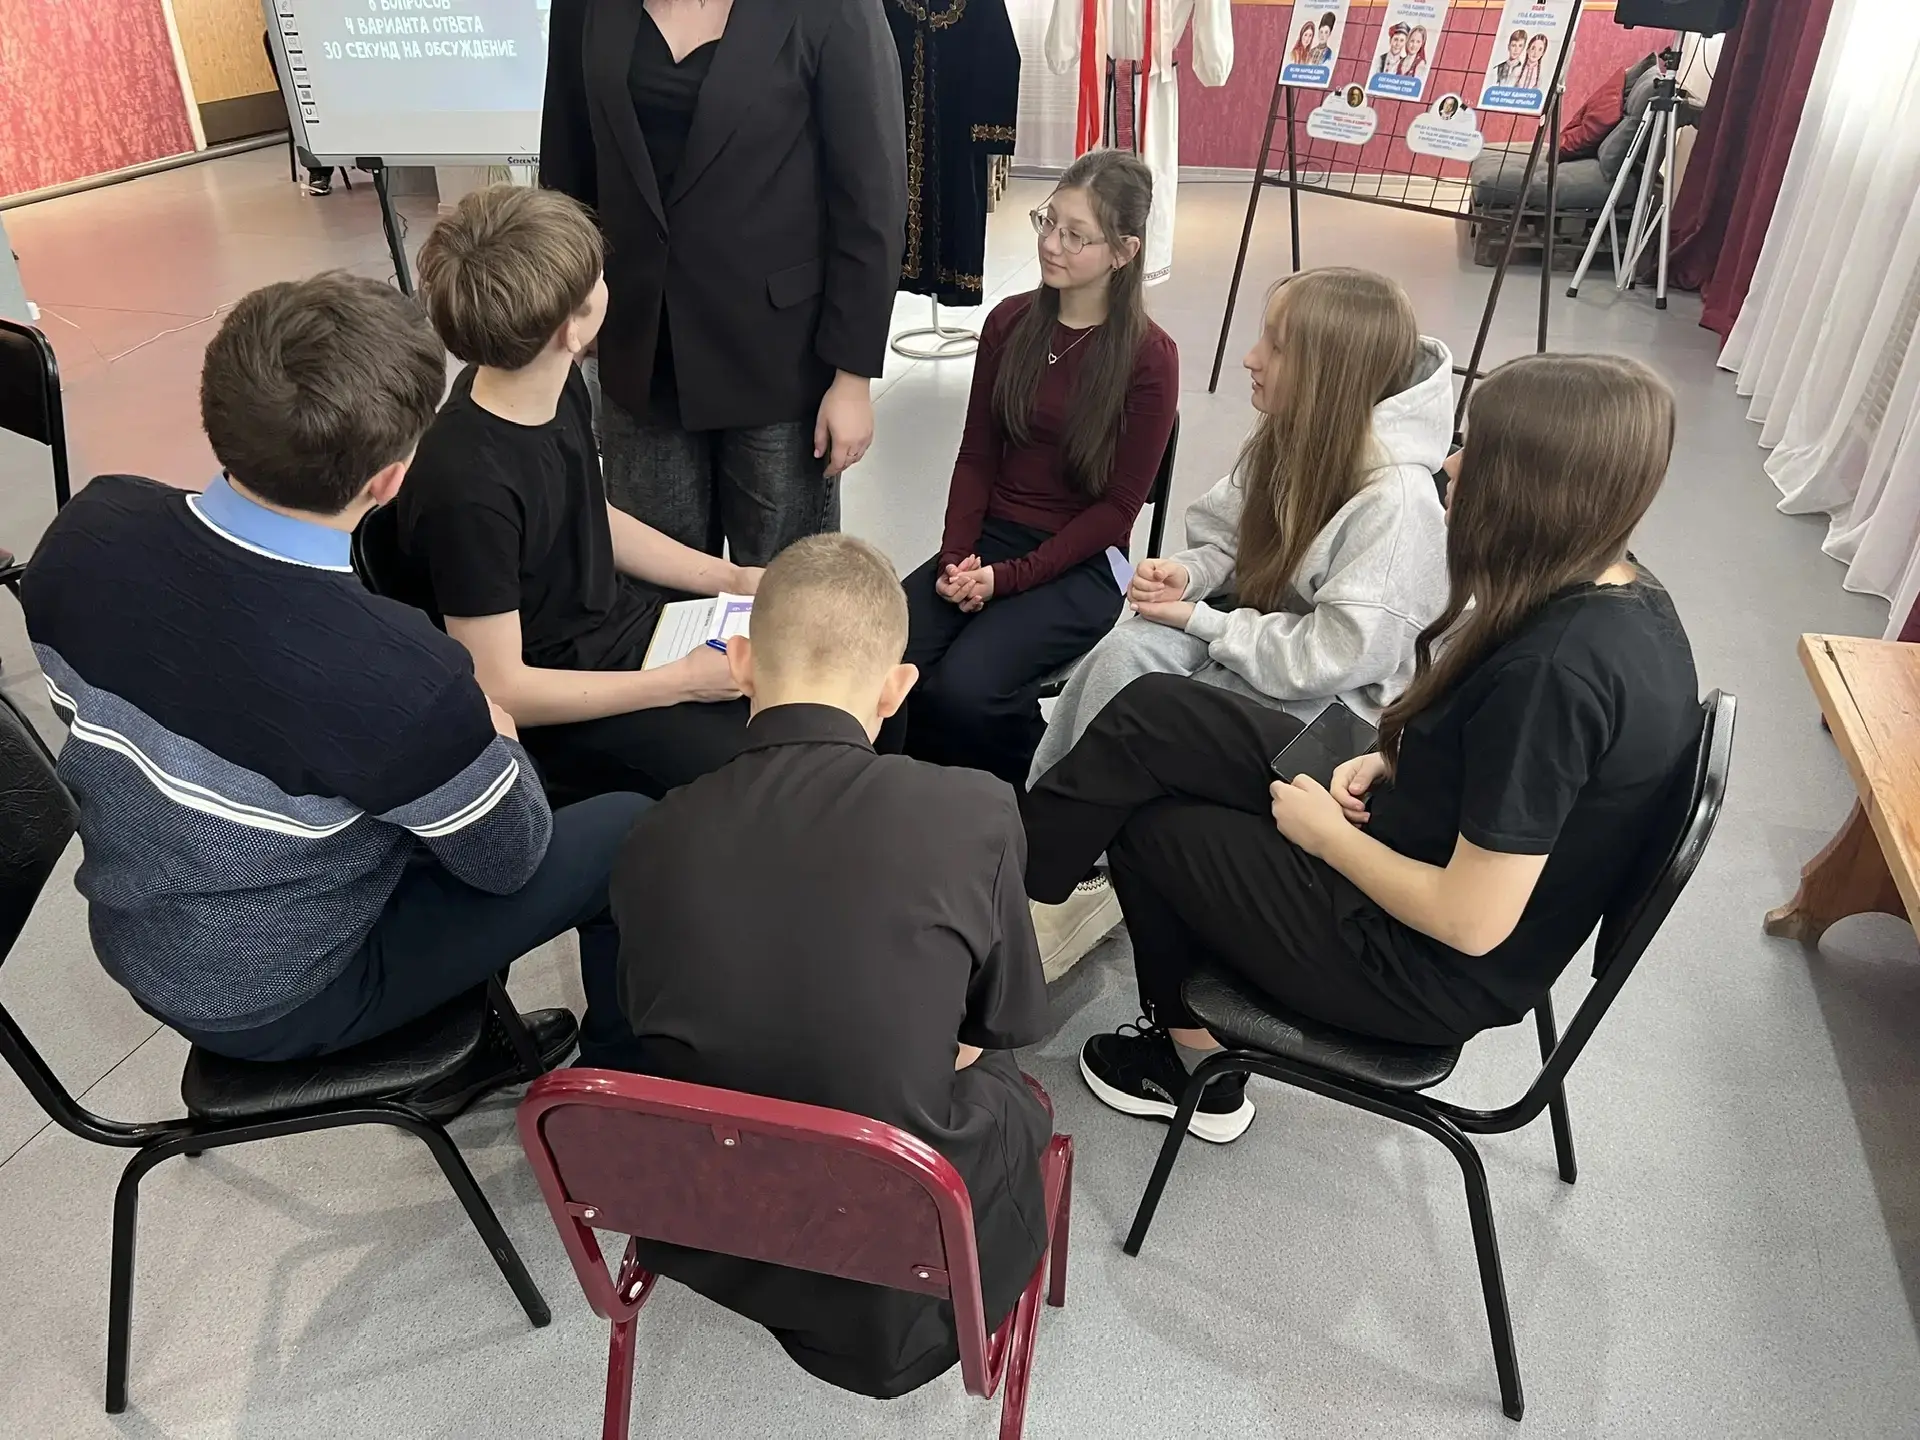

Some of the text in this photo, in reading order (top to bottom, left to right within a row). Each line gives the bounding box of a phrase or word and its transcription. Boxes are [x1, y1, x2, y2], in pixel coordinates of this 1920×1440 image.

[344, 16, 485, 35] 4 ВАРИАНТА ОТВЕТА
[323, 39, 518, 60] 30 СЕКУНД НА ОБСУЖДЕНИЕ
